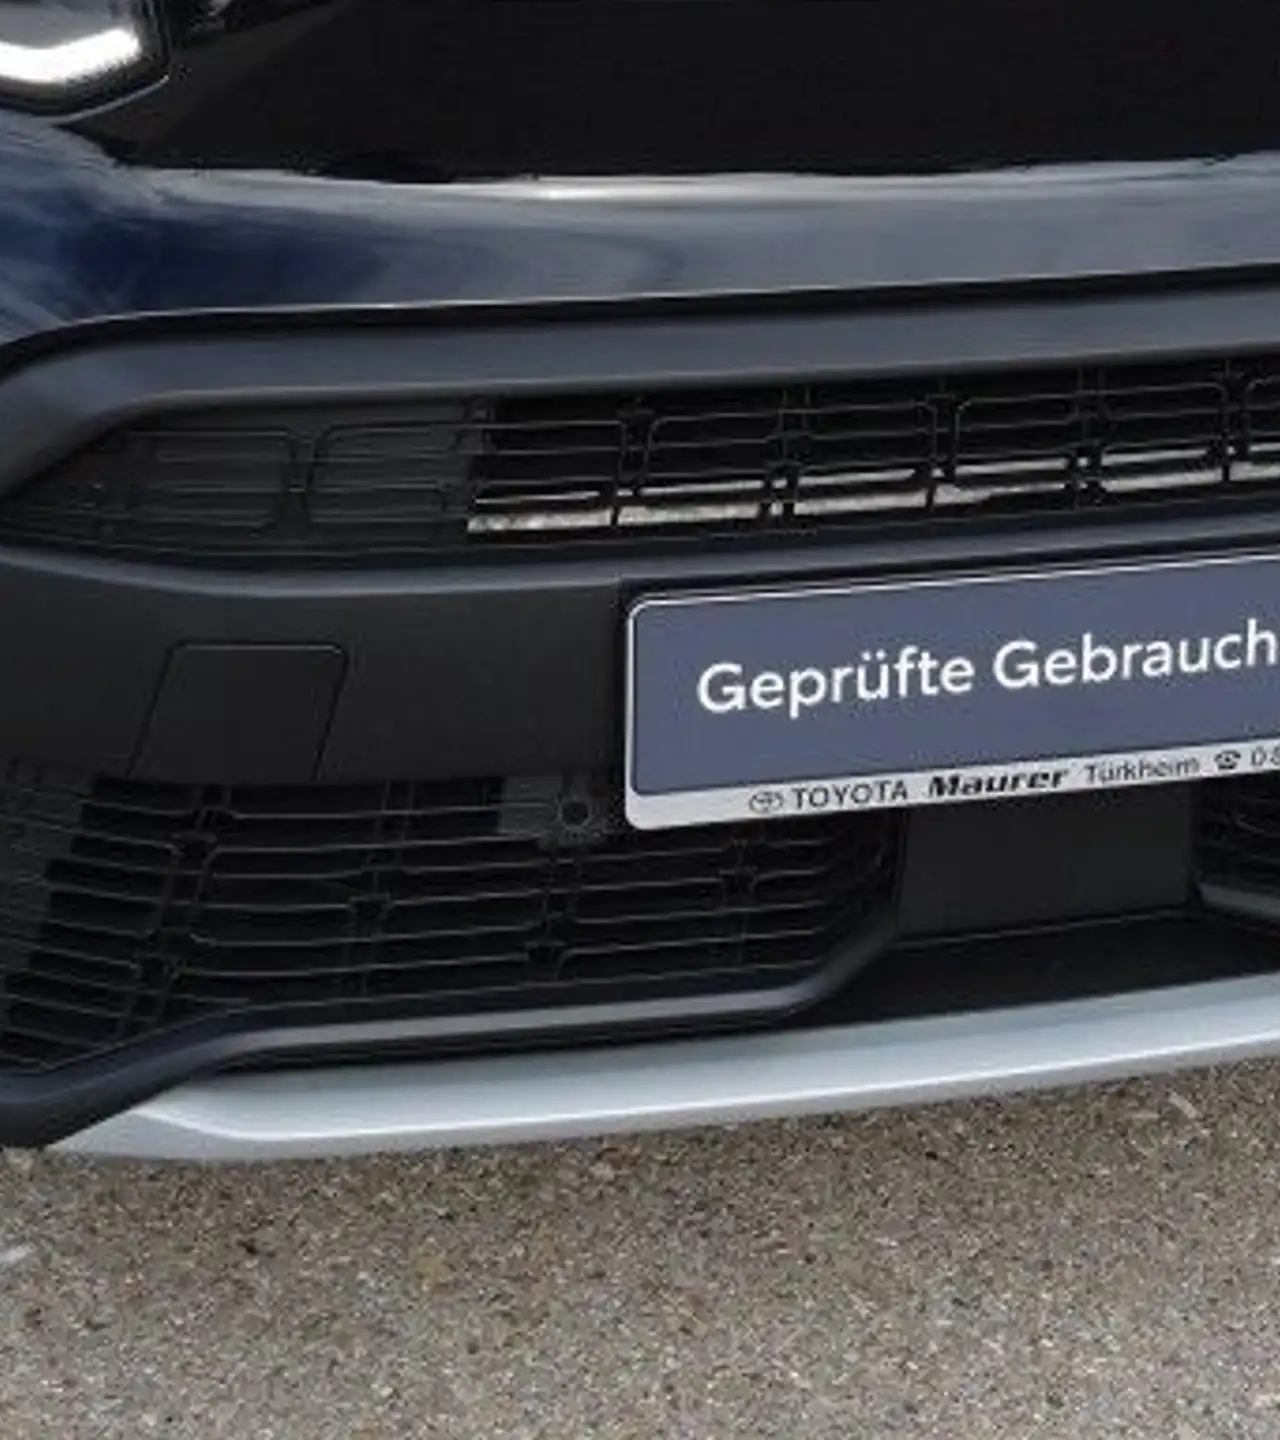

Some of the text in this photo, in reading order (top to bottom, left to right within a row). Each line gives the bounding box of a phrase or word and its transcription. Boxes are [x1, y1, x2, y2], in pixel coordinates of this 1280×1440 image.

[696, 645, 976, 720] Geprüfte
[791, 781, 909, 810] TOYOTA
[927, 766, 1070, 798] Maurer
